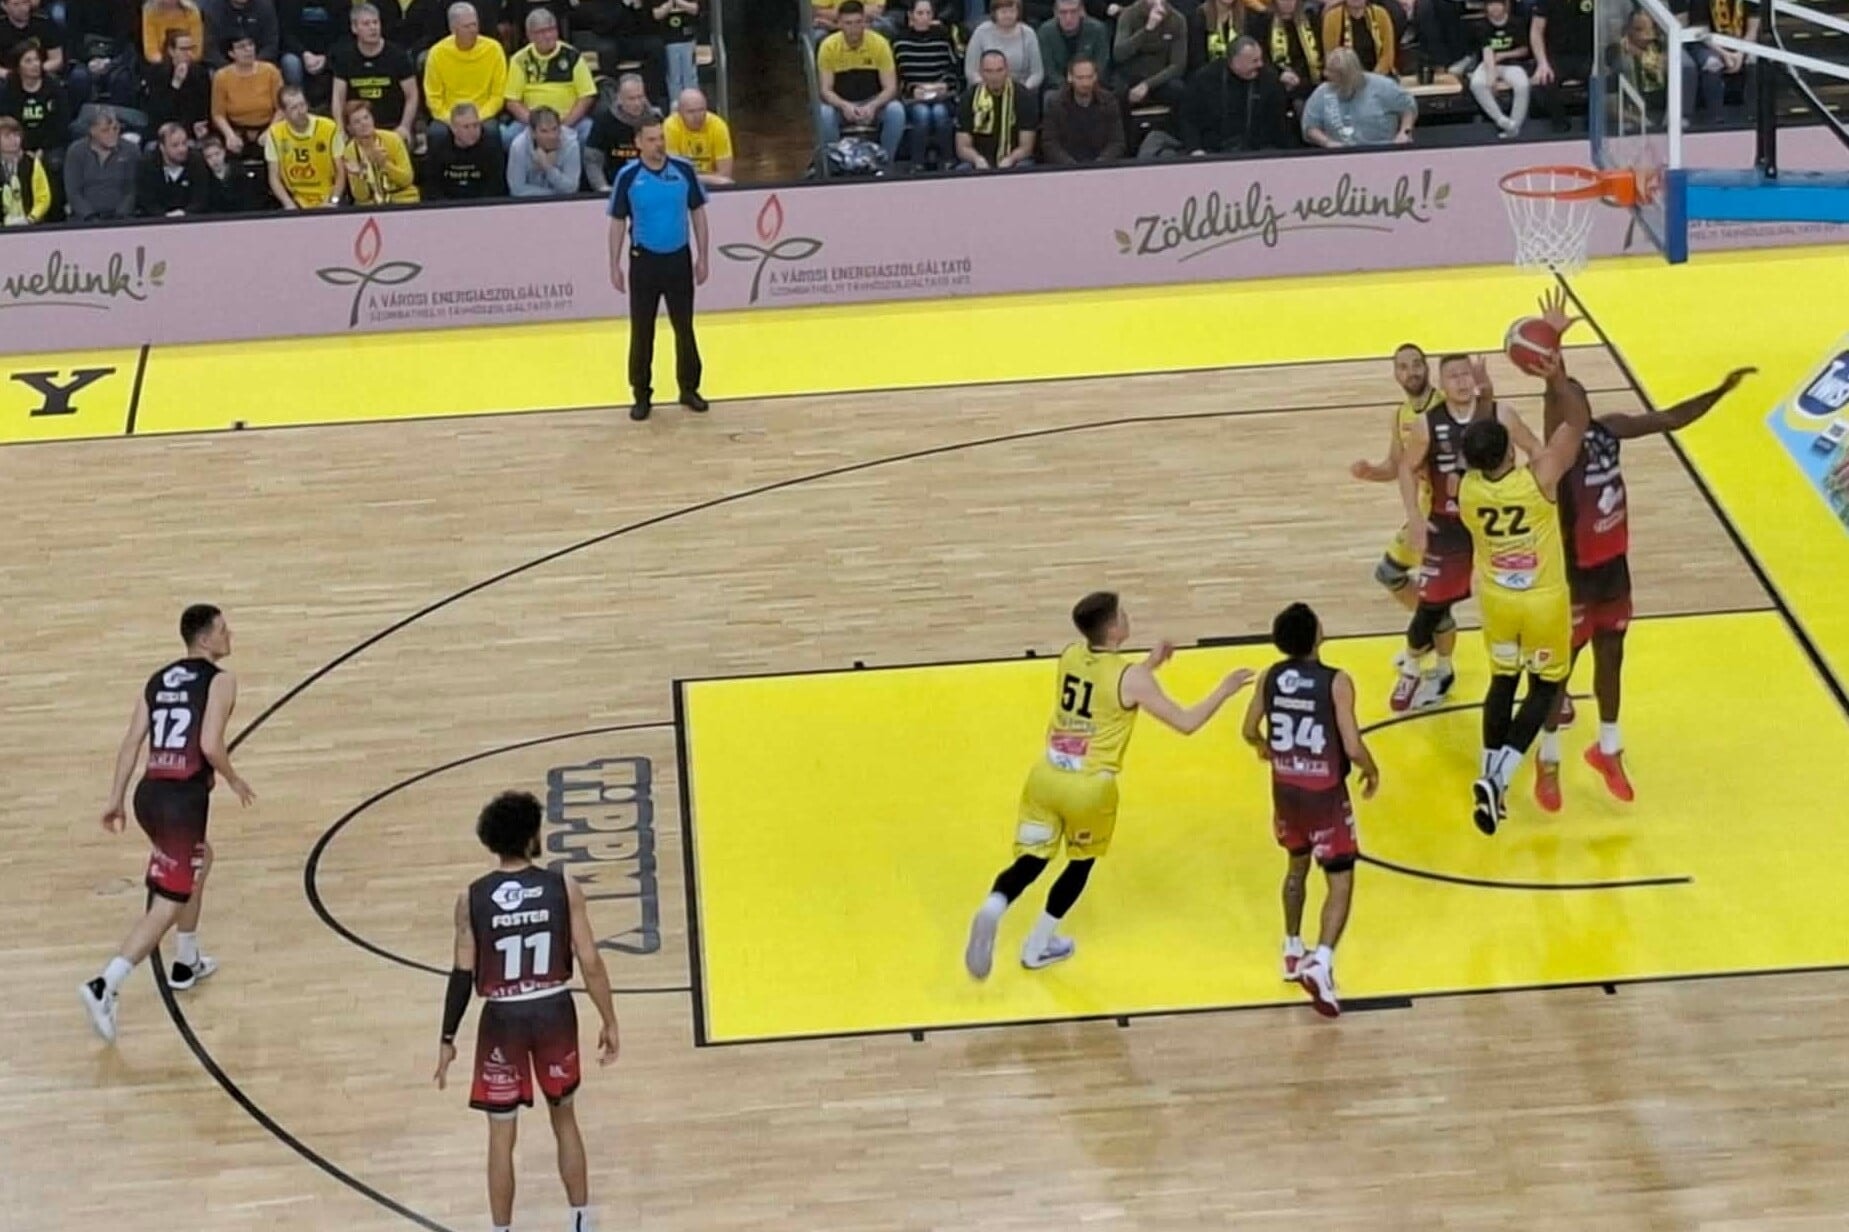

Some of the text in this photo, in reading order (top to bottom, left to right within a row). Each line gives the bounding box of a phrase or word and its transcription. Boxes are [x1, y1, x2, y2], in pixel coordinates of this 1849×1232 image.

[294, 147, 309, 163] 15
[1134, 169, 1432, 255] Zöldülj velünk!
[3, 245, 147, 301] velünk!
[782, 267, 828, 283] VÁROSI
[831, 257, 971, 281] ENERGIASZOLGÁLTATÓ
[382, 291, 428, 308] VÁROSI
[432, 283, 573, 305] ENERGIASZOLGÁLTATÓ
[10, 367, 116, 417] Y
[1476, 505, 1531, 537] 22
[1060, 673, 1095, 720] 51
[152, 708, 192, 749] 12
[1269, 712, 1326, 754] 34
[491, 909, 549, 929] FOSTER
[494, 931, 551, 981] 11
